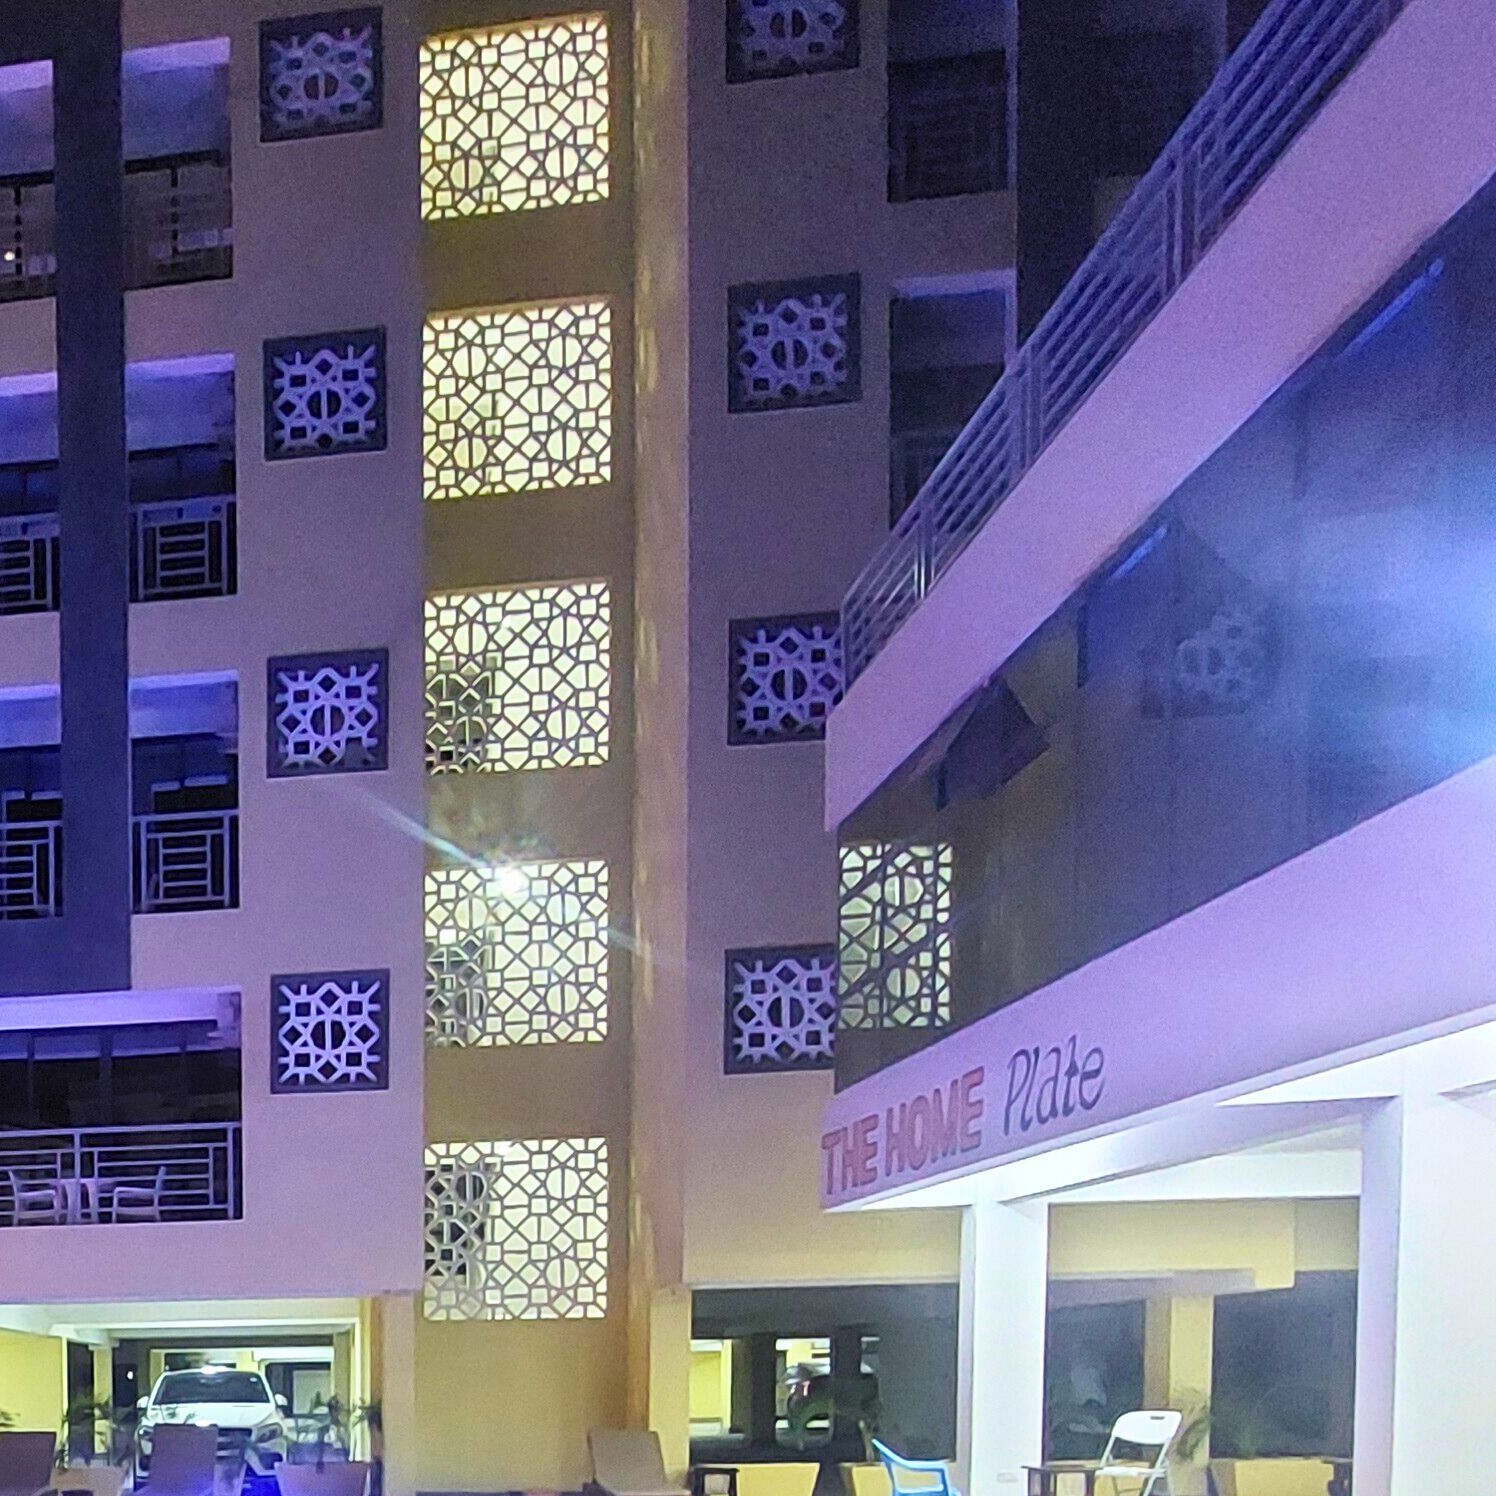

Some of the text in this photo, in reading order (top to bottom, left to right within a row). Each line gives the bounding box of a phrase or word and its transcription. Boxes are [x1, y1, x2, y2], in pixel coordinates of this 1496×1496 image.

[821, 1034, 1104, 1195] THE HOME Plate
